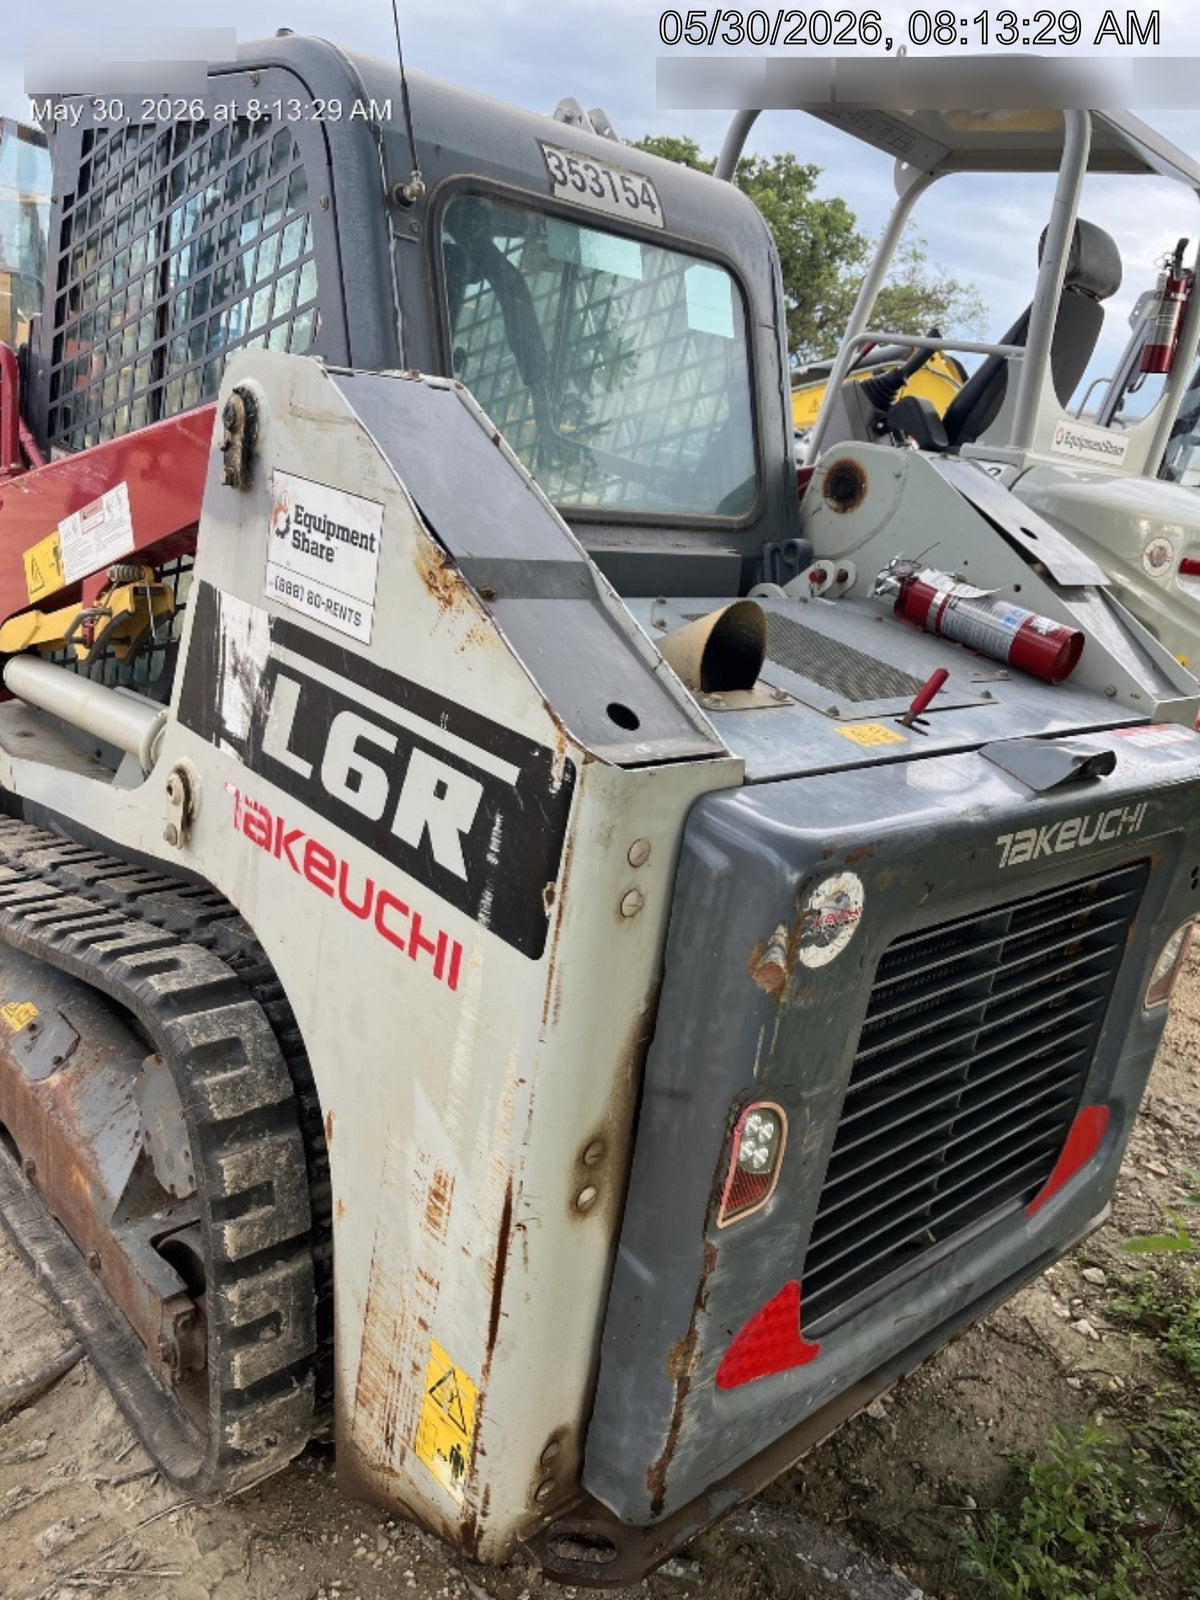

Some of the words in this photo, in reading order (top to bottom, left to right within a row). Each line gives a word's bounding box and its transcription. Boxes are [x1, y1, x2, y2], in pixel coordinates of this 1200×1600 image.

[546, 150, 657, 215] 353154
[291, 529, 336, 563] Share
[293, 504, 377, 554] Equipment
[306, 590, 362, 627] 80-RENTS
[261, 673, 484, 882] L6R
[995, 801, 1149, 868] TAKEUCHI
[224, 782, 464, 992] TAKEUCHI
